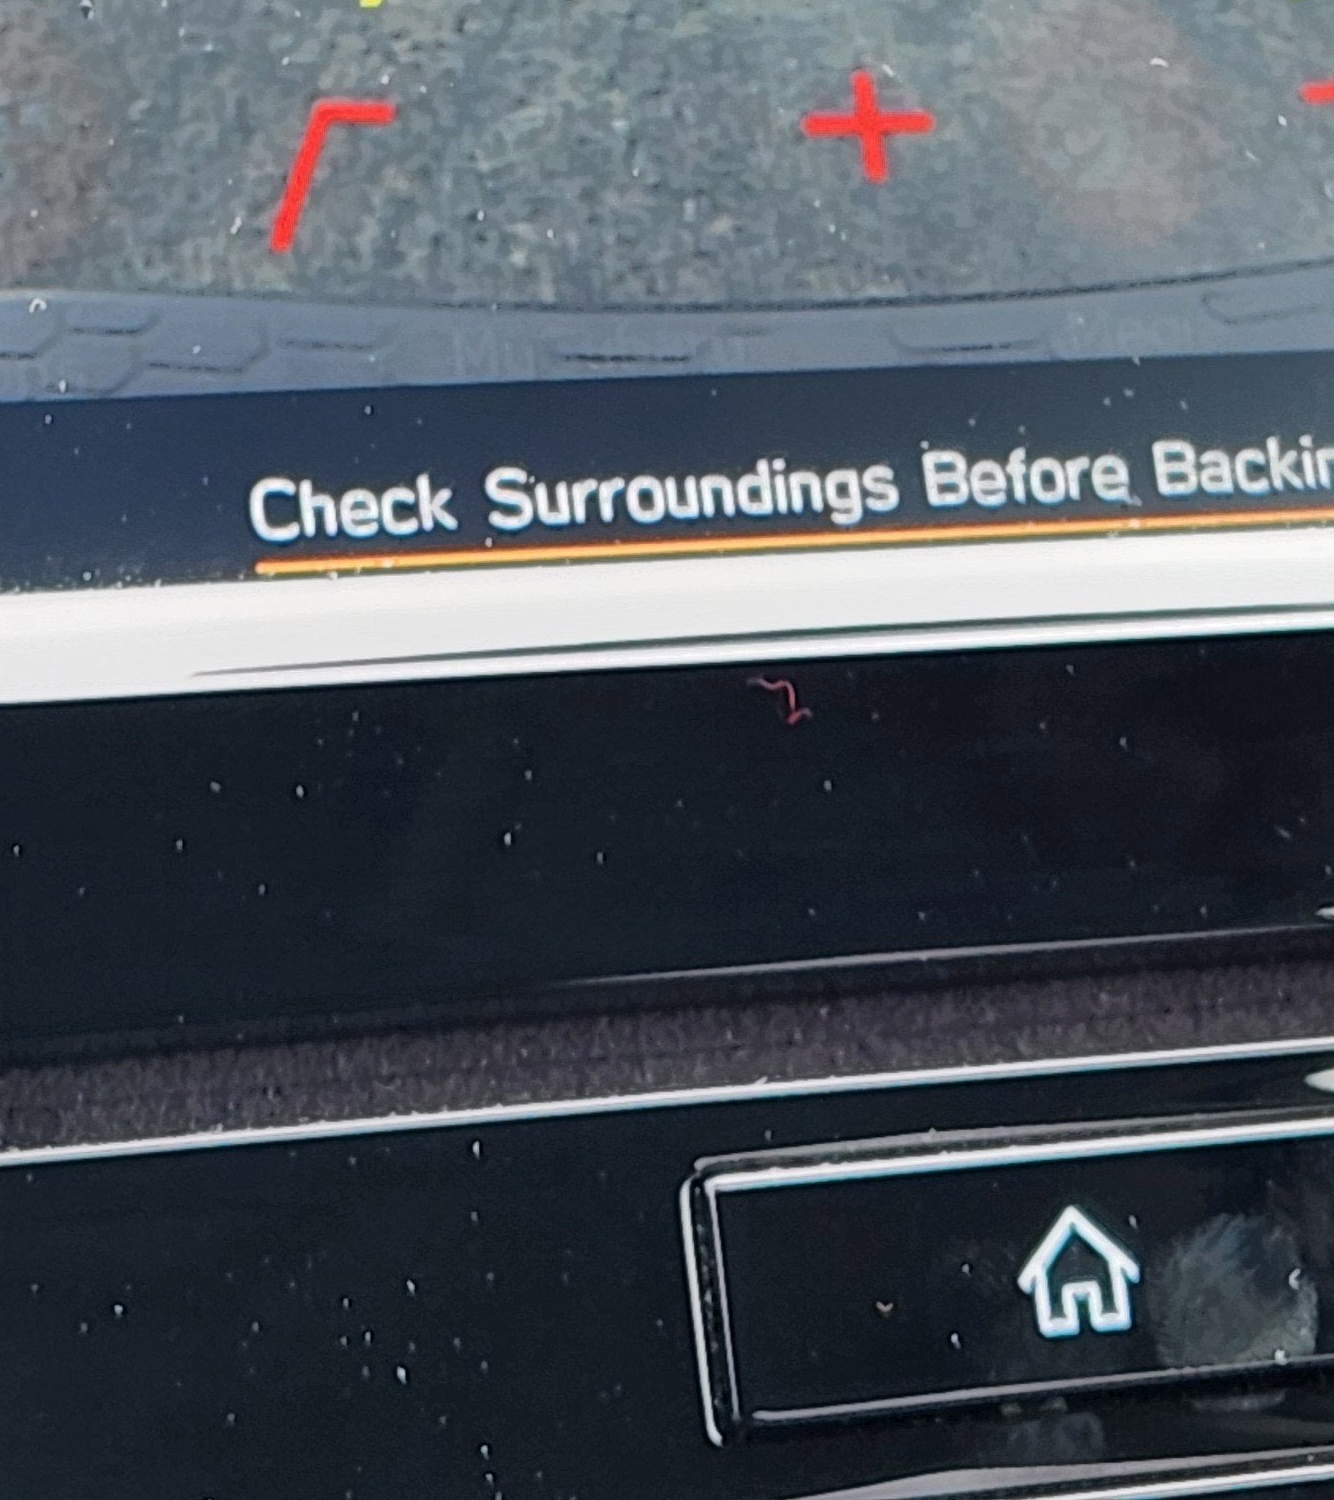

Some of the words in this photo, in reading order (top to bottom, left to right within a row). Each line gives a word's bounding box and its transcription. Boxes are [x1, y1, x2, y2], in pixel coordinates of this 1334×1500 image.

[249, 474, 459, 543] Check
[483, 457, 900, 532] Surroundings
[920, 446, 1131, 508] Before
